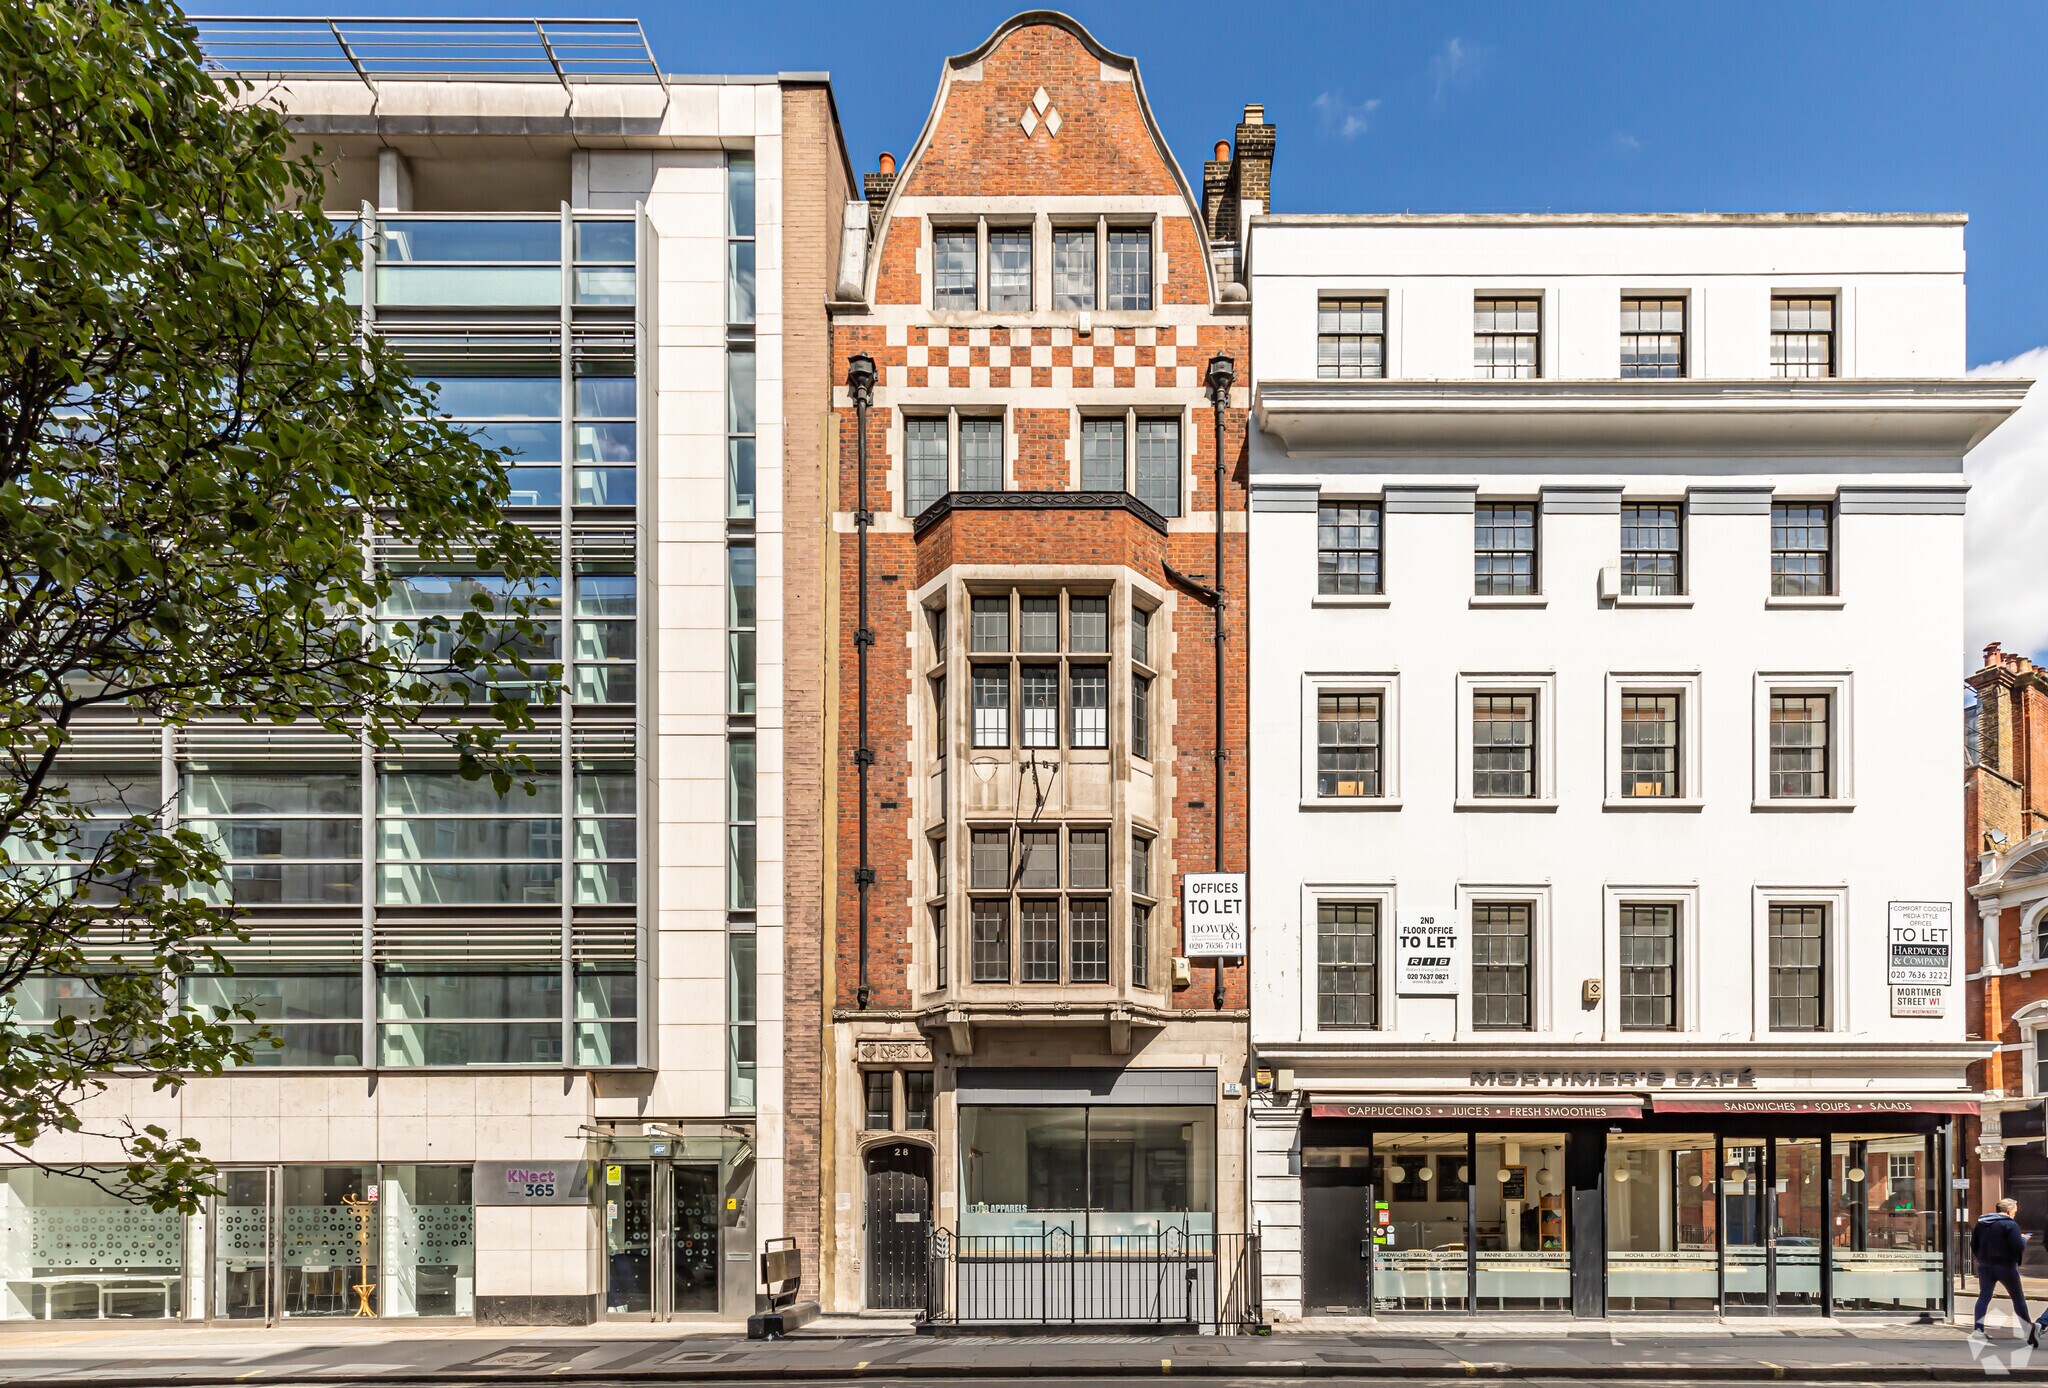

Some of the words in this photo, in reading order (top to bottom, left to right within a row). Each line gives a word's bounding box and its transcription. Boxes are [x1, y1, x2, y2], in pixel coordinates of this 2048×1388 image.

[1192, 883, 1238, 894] OFFICES
[1189, 899, 1209, 914] TO
[1214, 899, 1242, 914] LET
[1420, 916, 1435, 924] 2ND
[1403, 926, 1426, 934] FLOOR
[1428, 926, 1453, 934] OFFICE
[1893, 928, 1916, 942] TO
[1922, 928, 1948, 942] LET
[1189, 942, 1203, 950] 020
[1400, 936, 1421, 948] TO
[1427, 936, 1457, 948] LET
[1893, 945, 1947, 956] HARDWICKE
[1409, 958, 1449, 966] RIB
[1893, 957, 1902, 965] &
[1903, 956, 1947, 966] COMPANY
[1891, 971, 1906, 979] 020
[1909, 971, 1926, 979] 7636
[1929, 971, 1948, 979] 3222
[1897, 988, 1941, 996] MORTIMER
[1897, 997, 1926, 1006] STREET
[1929, 997, 1940, 1006] W1
[1469, 1071, 1666, 1087] MORTIMER'S
[1347, 1106, 1431, 1116] CAPPUCCINOS
[1451, 1106, 1490, 1116] JUICES
[1509, 1107, 1541, 1117] FRESH
[1544, 1107, 1607, 1117] SMOOTHIES
[1723, 1102, 1796, 1112] SANDWICHES
[1814, 1102, 1850, 1112] SOUPS
[1869, 1102, 1912, 1111] SALADS
[894, 1148, 909, 1156] 28
[508, 1169, 555, 1183] KNect
[525, 1184, 555, 1197] 365
[990, 1204, 1027, 1213] APPARELS
